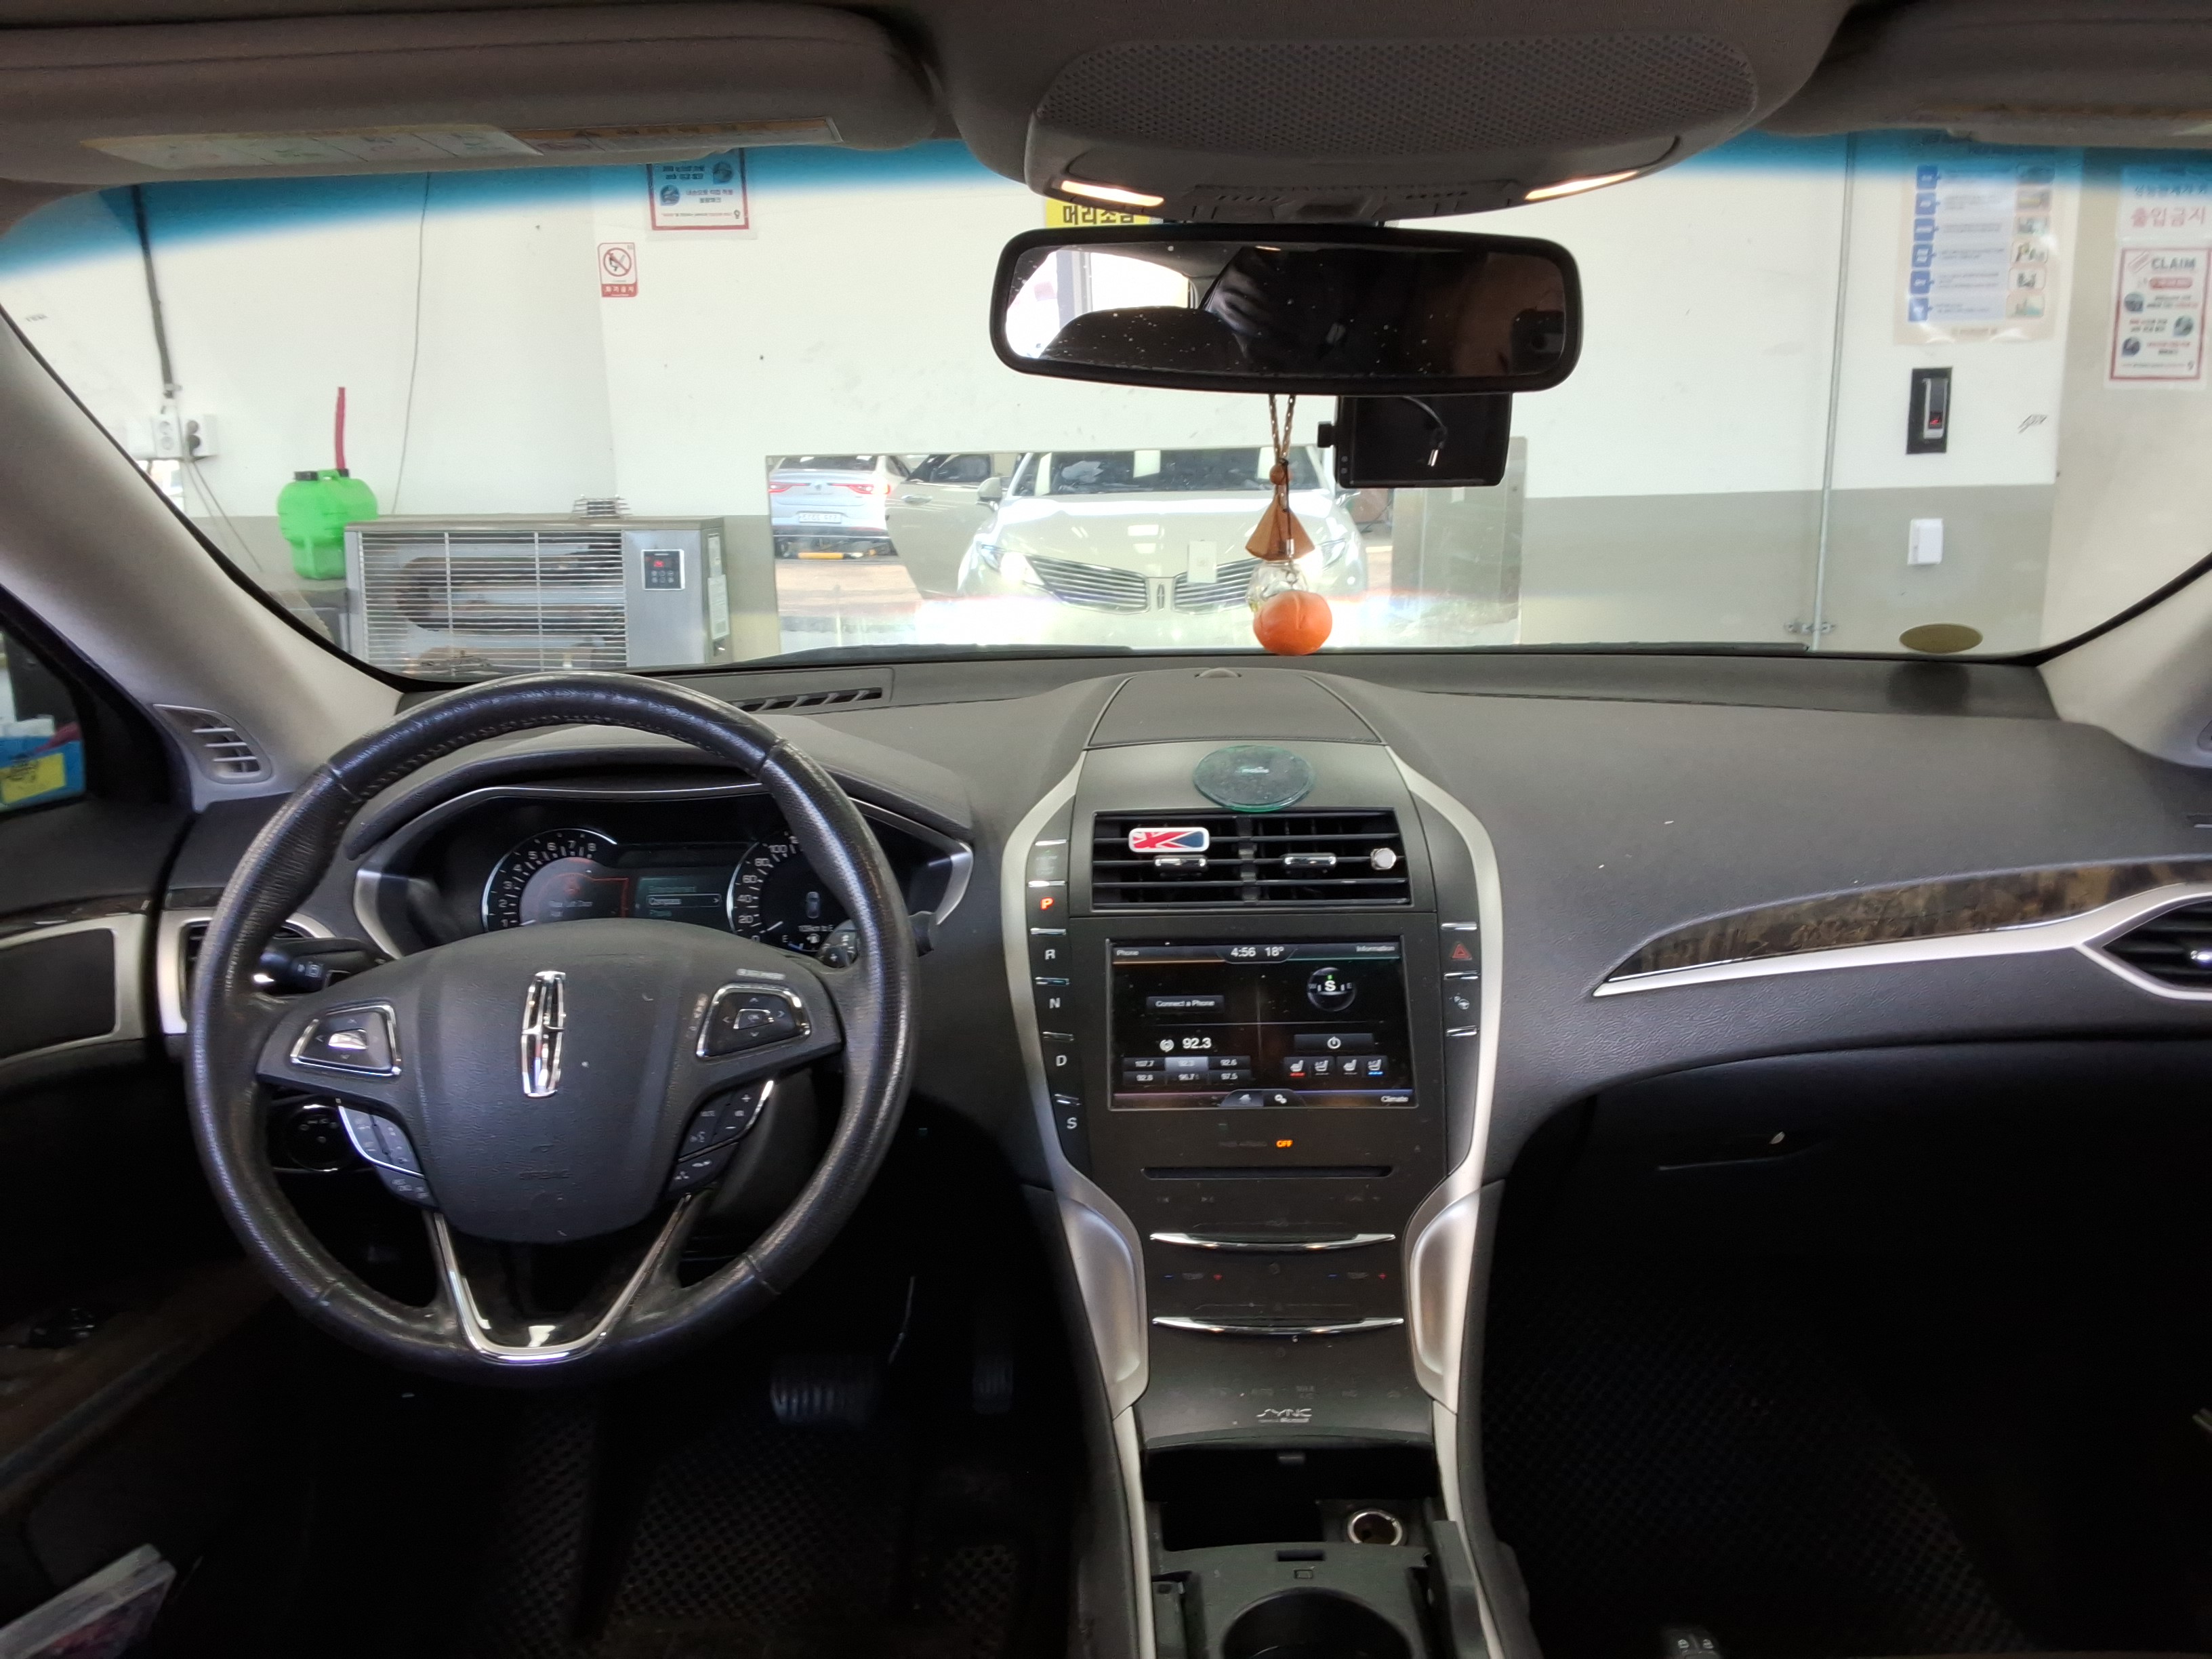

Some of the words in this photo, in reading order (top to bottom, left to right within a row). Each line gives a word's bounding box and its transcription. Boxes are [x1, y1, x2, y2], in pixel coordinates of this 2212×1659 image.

[2150, 257, 2196, 270] CLAIM
[568, 840, 576, 848] 7
[769, 844, 787, 853] 100
[528, 851, 538, 859] 5
[754, 858, 770, 866] 80
[742, 875, 758, 883] 60
[502, 881, 512, 890] 3
[497, 899, 508, 907] 2
[737, 895, 753, 903] 40
[1040, 897, 1054, 909] P
[500, 919, 508, 928] 1
[738, 915, 754, 924] 20
[1044, 949, 1056, 960] R
[1230, 946, 1256, 957] 4:56
[1324, 980, 1336, 991] S
[1049, 998, 1061, 1008] N
[1182, 1037, 1212, 1049] 92.3
[1055, 1054, 1067, 1067] D
[1066, 1117, 1078, 1130] S
[1275, 1139, 1293, 1148] OFF
